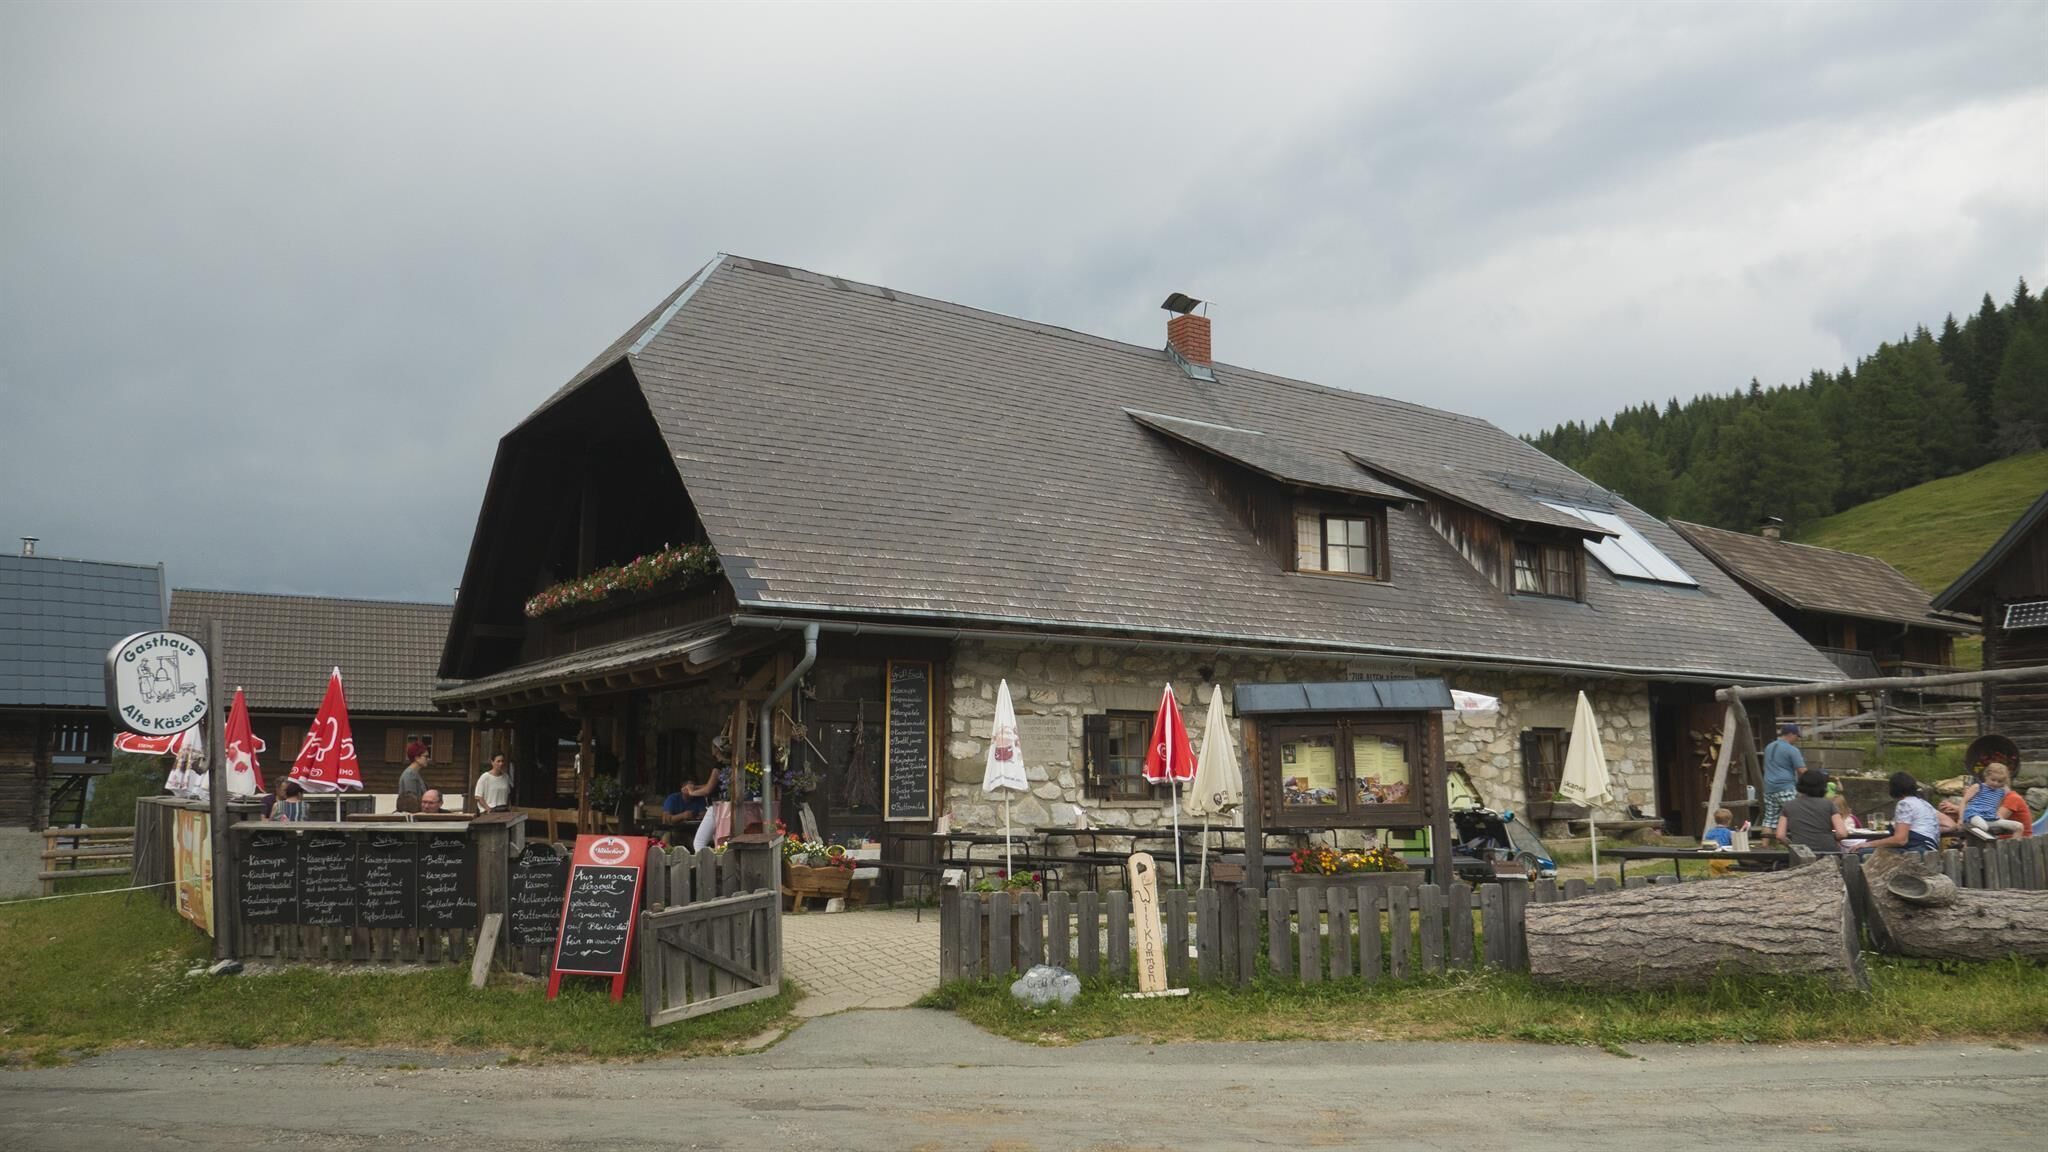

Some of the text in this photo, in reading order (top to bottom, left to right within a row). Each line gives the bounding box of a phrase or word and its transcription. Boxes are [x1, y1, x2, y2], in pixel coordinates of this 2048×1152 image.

[123, 634, 196, 662] Gasthaus
[122, 698, 206, 729] Alte Käserei
